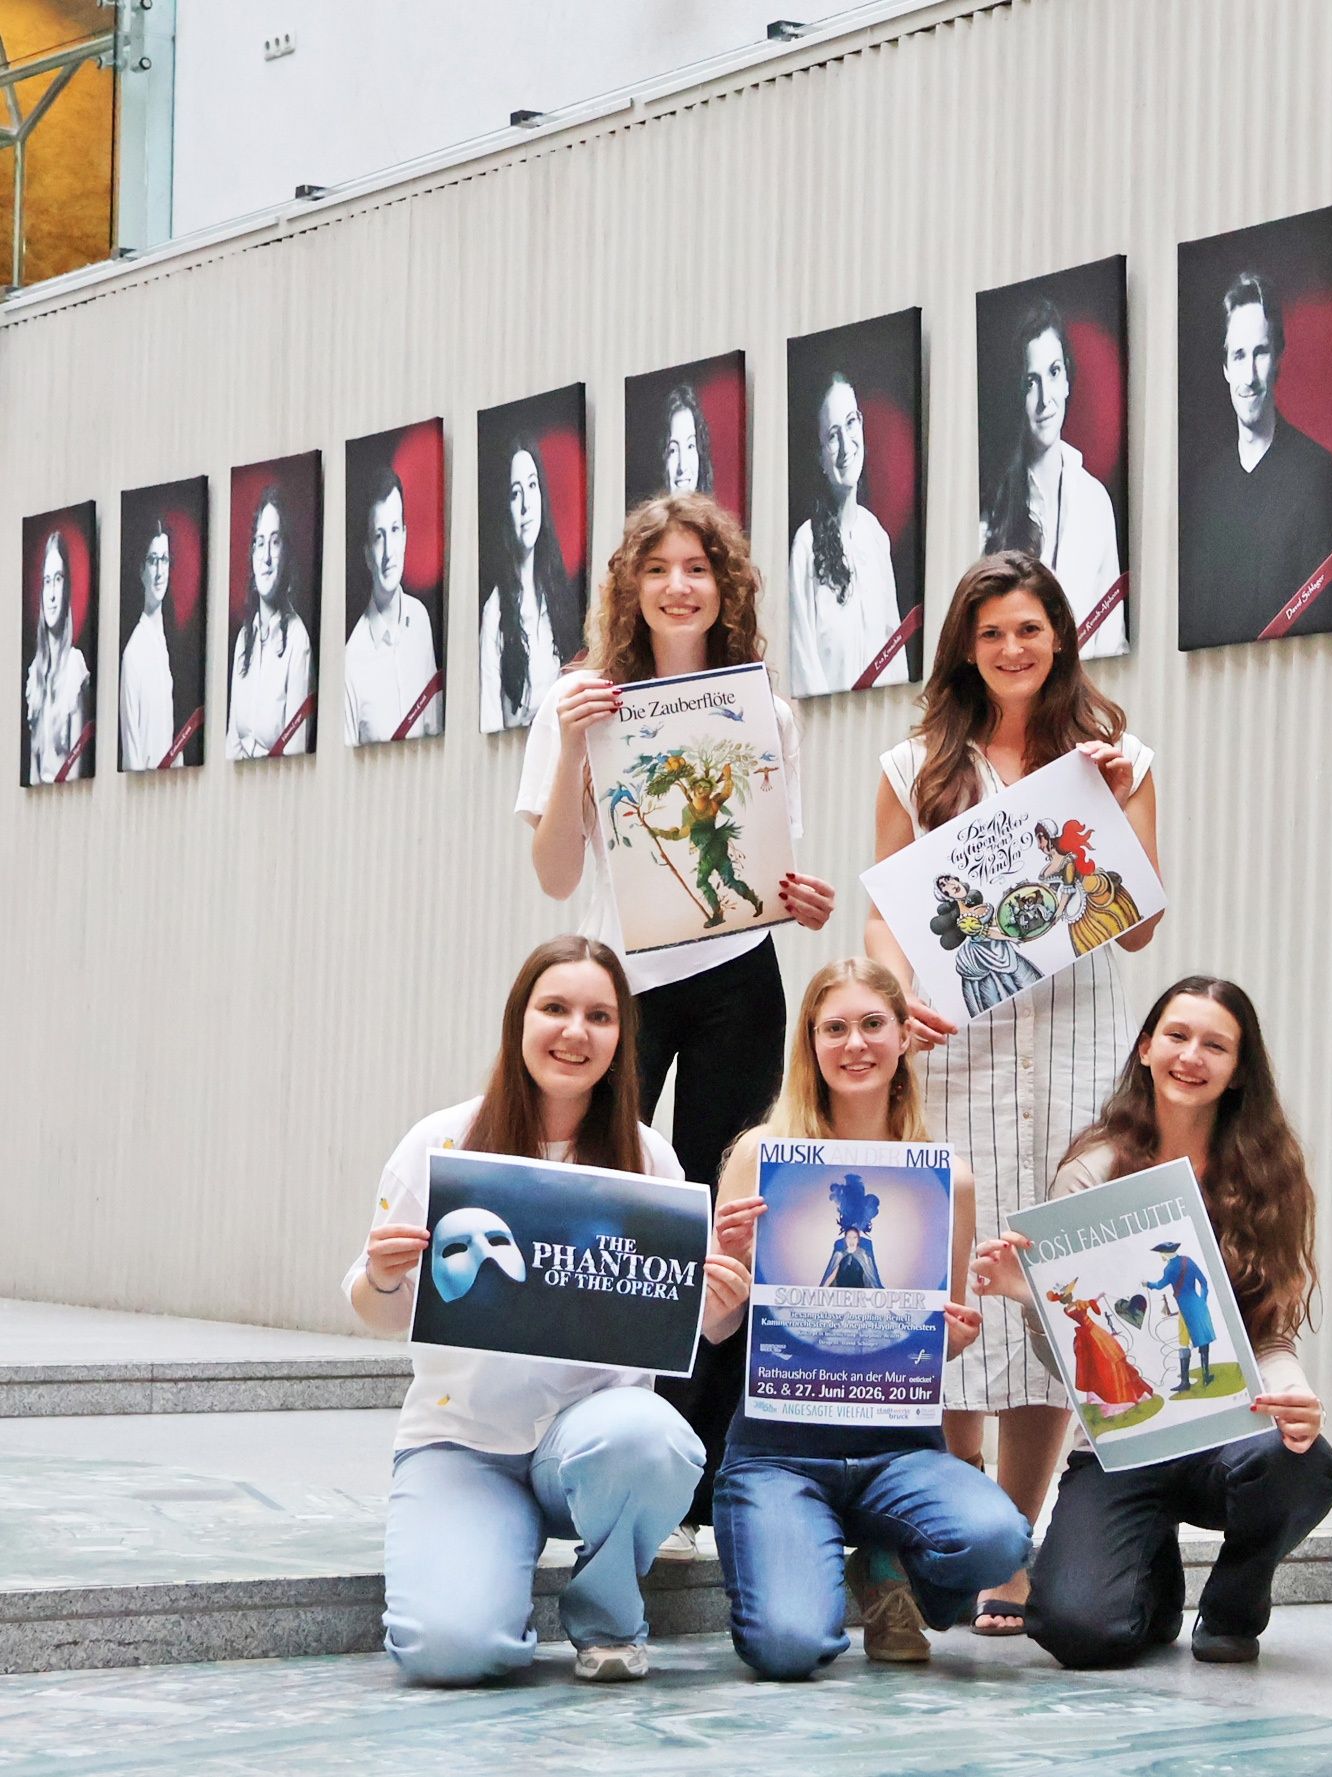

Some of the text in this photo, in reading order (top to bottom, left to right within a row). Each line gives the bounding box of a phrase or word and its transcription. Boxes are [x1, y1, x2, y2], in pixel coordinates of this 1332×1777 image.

[618, 690, 737, 723] Die Zauberflöte
[760, 1143, 826, 1165] MUSIK
[906, 1148, 950, 1169] MUR
[1076, 1218, 1119, 1254] FAN
[1119, 1197, 1190, 1237] TUTTE
[596, 1234, 637, 1254] THE
[531, 1241, 698, 1287] PHANTOM
[544, 1269, 680, 1301] OF THE OPERA
[774, 1287, 926, 1310] SOMMER-OPER
[758, 1366, 818, 1380] Rathaushof
[819, 1368, 849, 1381] Bruck
[850, 1372, 864, 1382] an
[866, 1371, 883, 1383] der
[885, 1371, 907, 1383] Mur
[757, 1382, 933, 1401] 26. & 27. Juni 2026, 20 Uhr
[782, 1403, 833, 1418] ANGESAGTE
[836, 1404, 874, 1419] VIELFALT
